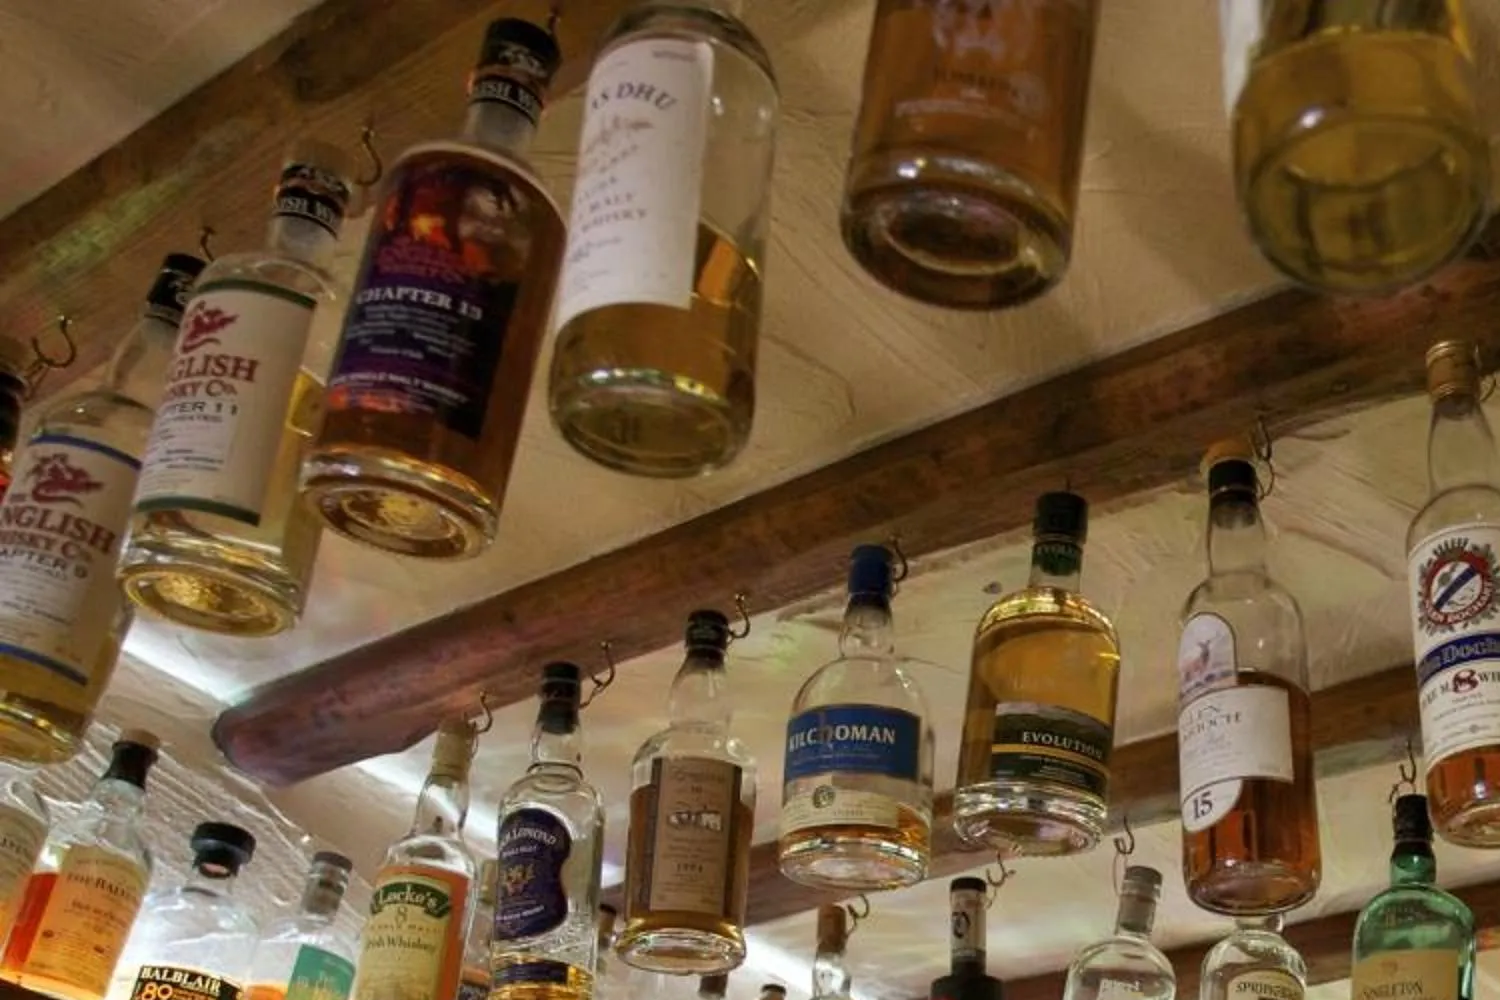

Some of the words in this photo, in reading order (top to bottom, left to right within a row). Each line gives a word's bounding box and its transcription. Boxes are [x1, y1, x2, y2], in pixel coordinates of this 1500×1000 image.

[172, 354, 258, 382] GLISH
[0, 504, 116, 554] NGLISH
[1022, 730, 1104, 760] EVOLUTION
[1193, 791, 1214, 821] 15
[378, 885, 440, 910] Locke's
[140, 964, 221, 995] BALBLAIR
